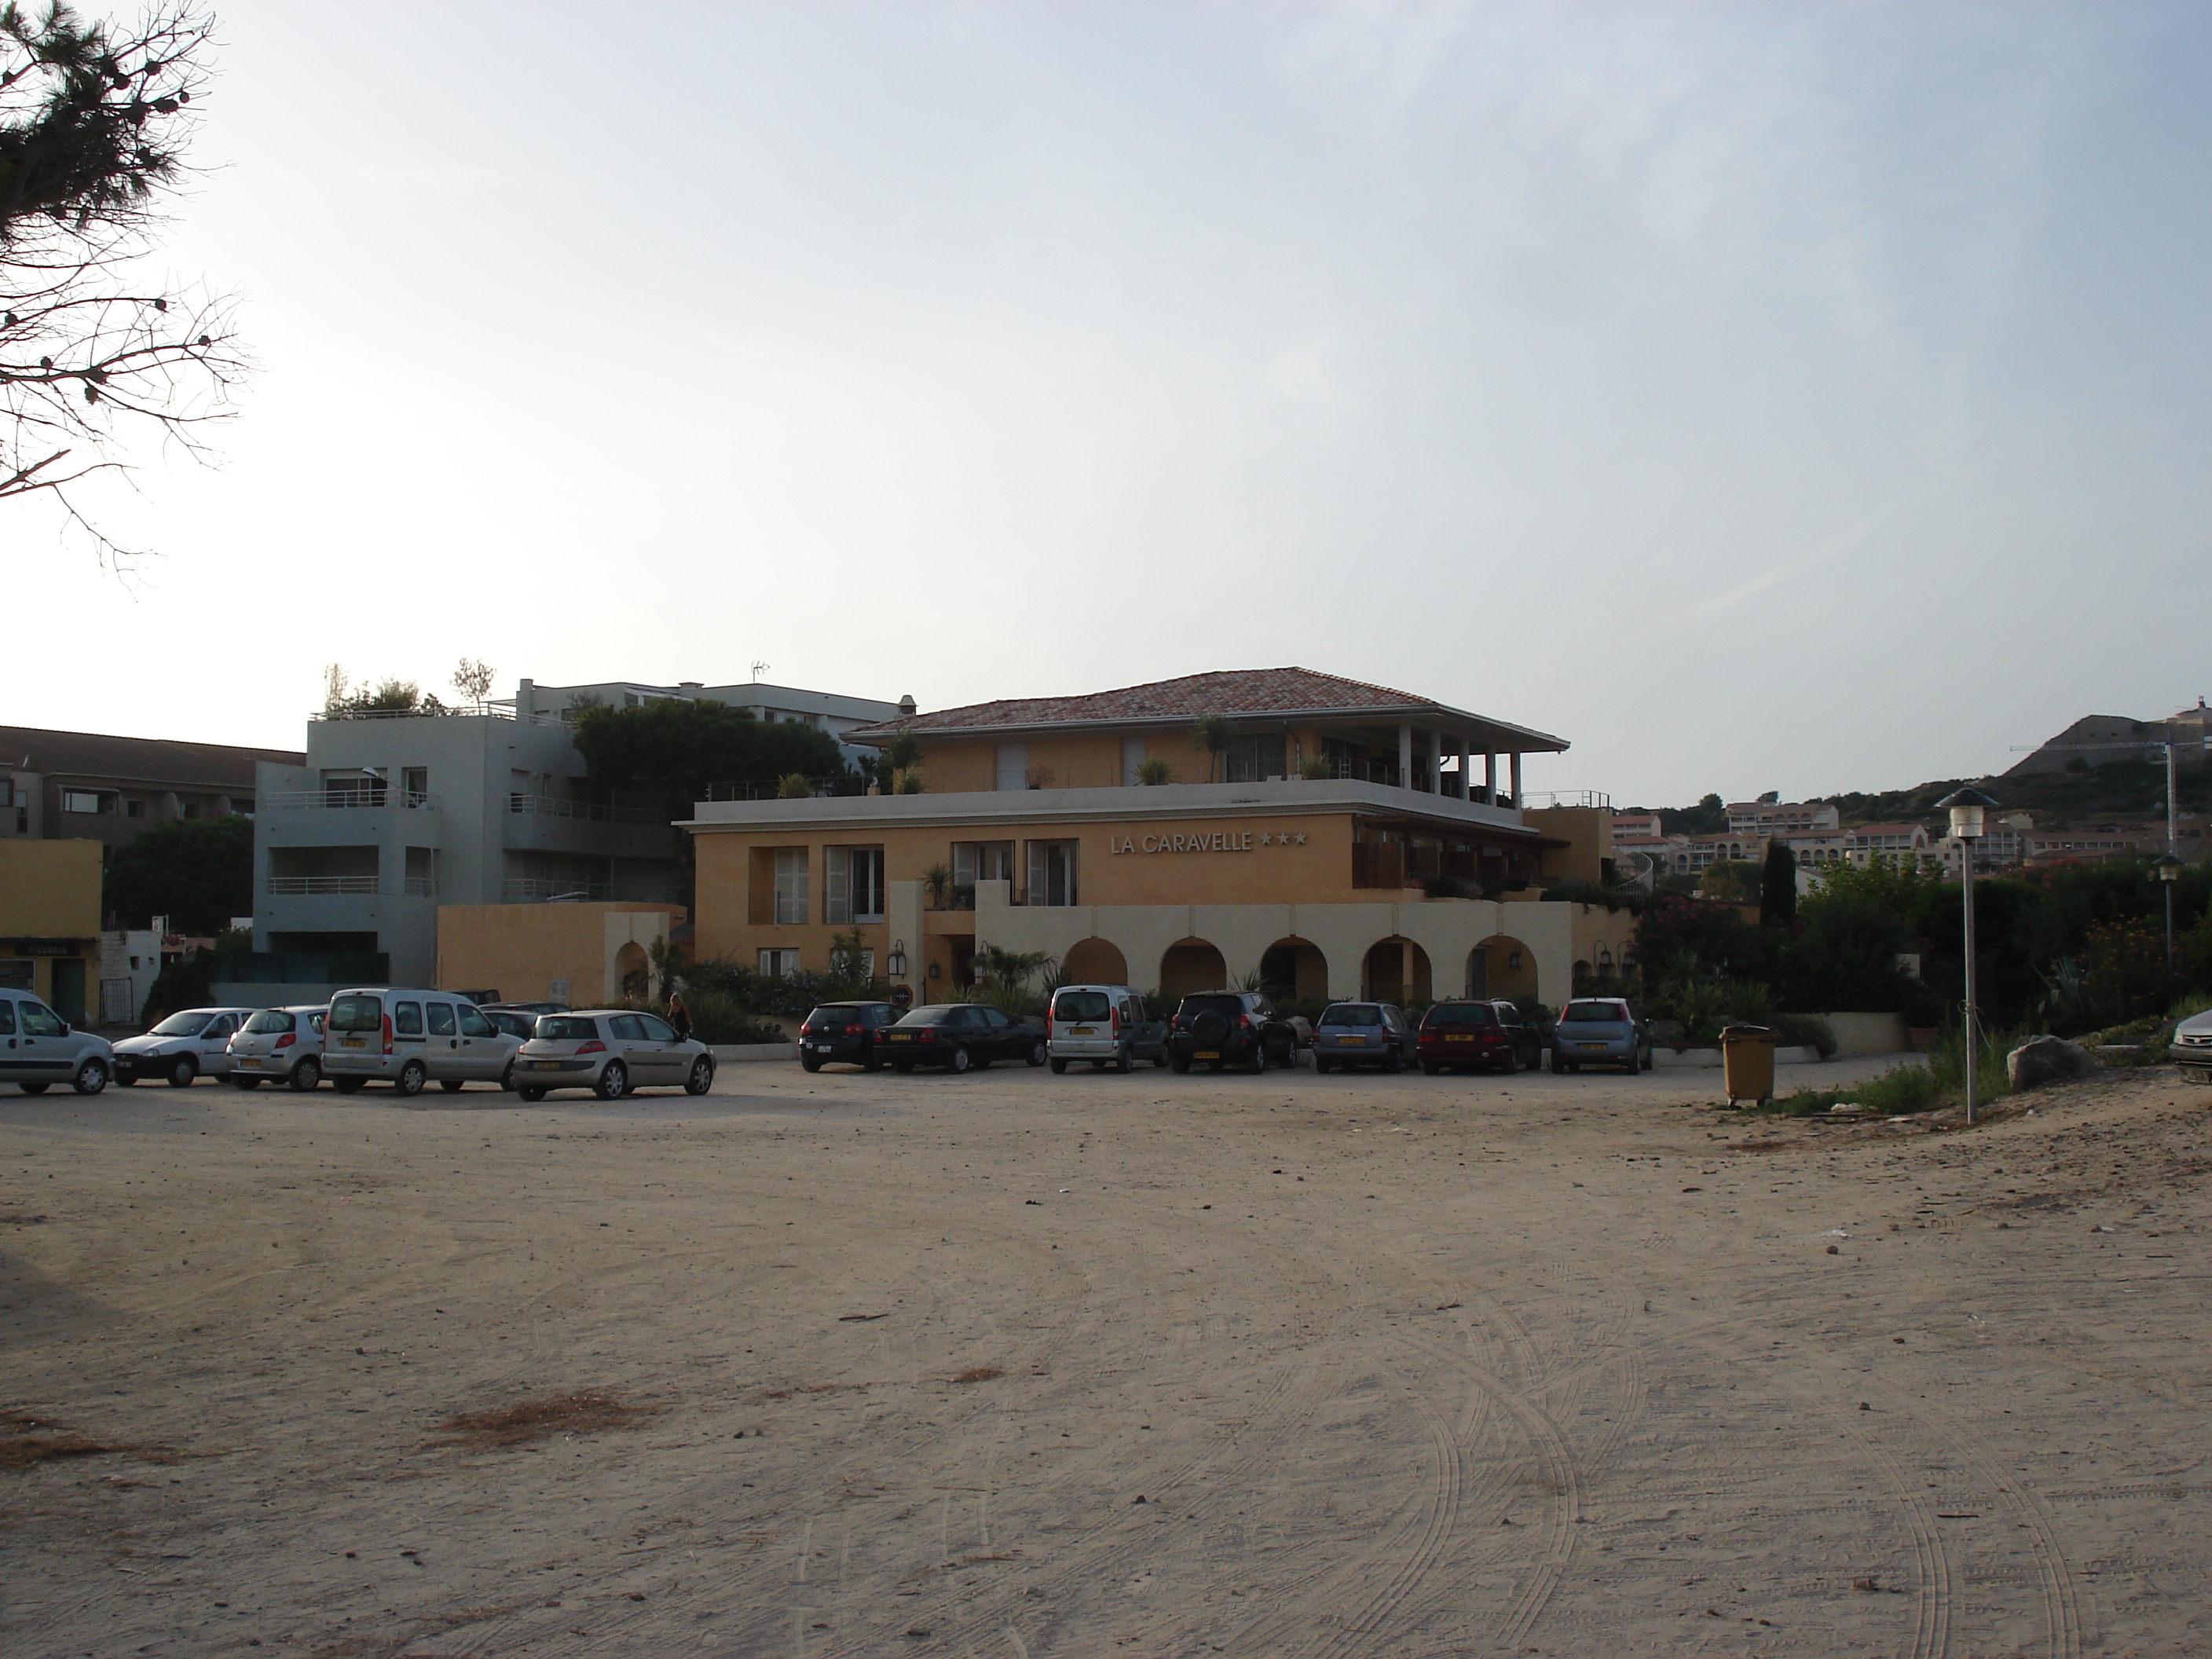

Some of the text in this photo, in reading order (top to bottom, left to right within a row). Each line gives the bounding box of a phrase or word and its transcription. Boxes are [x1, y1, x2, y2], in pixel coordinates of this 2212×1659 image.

[1111, 833, 1252, 854] LA CARAVELLE
[28, 946, 68, 954] PIZZERIA
